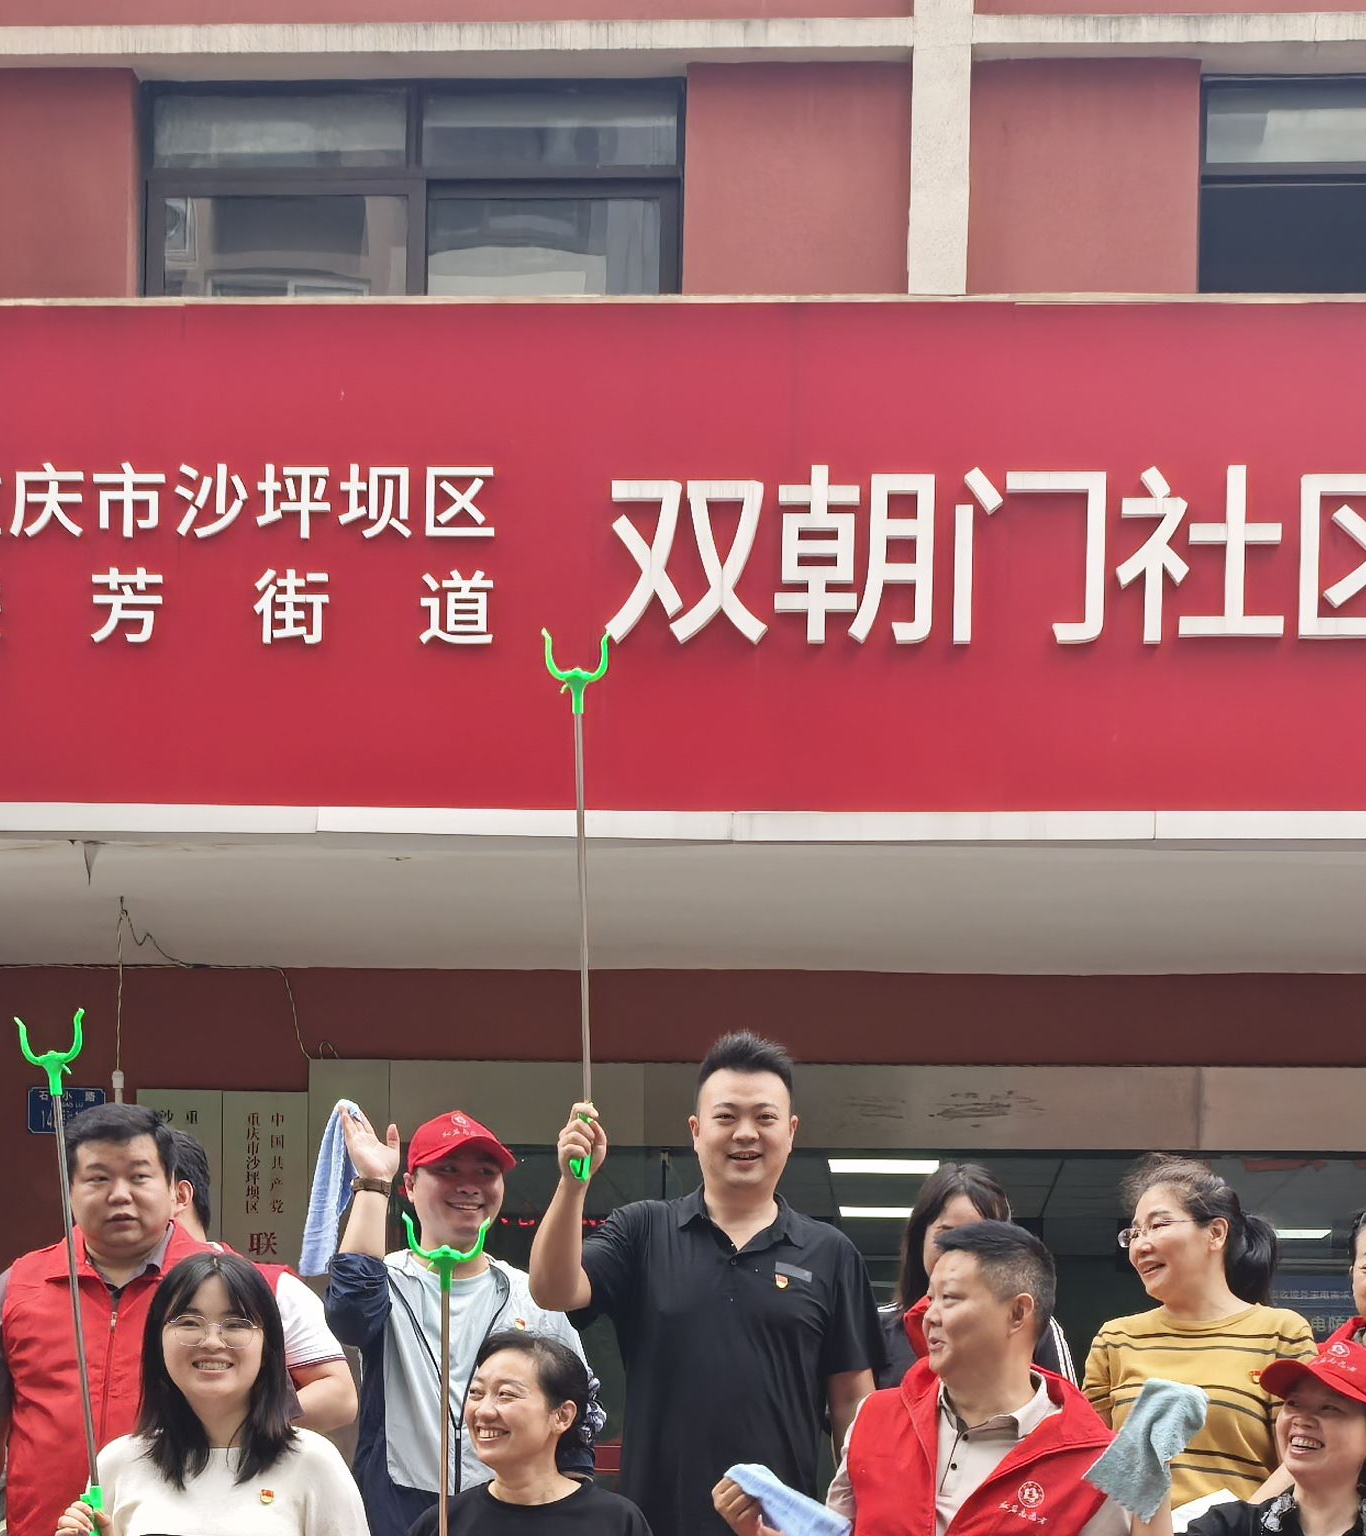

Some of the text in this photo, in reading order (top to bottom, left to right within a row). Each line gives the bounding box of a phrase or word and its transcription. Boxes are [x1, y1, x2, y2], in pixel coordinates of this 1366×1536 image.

[245, 1112, 261, 1214] 重庆市沙坪坝区
[269, 1112, 285, 1214] 中国共产党
[248, 1231, 278, 1264] 联
